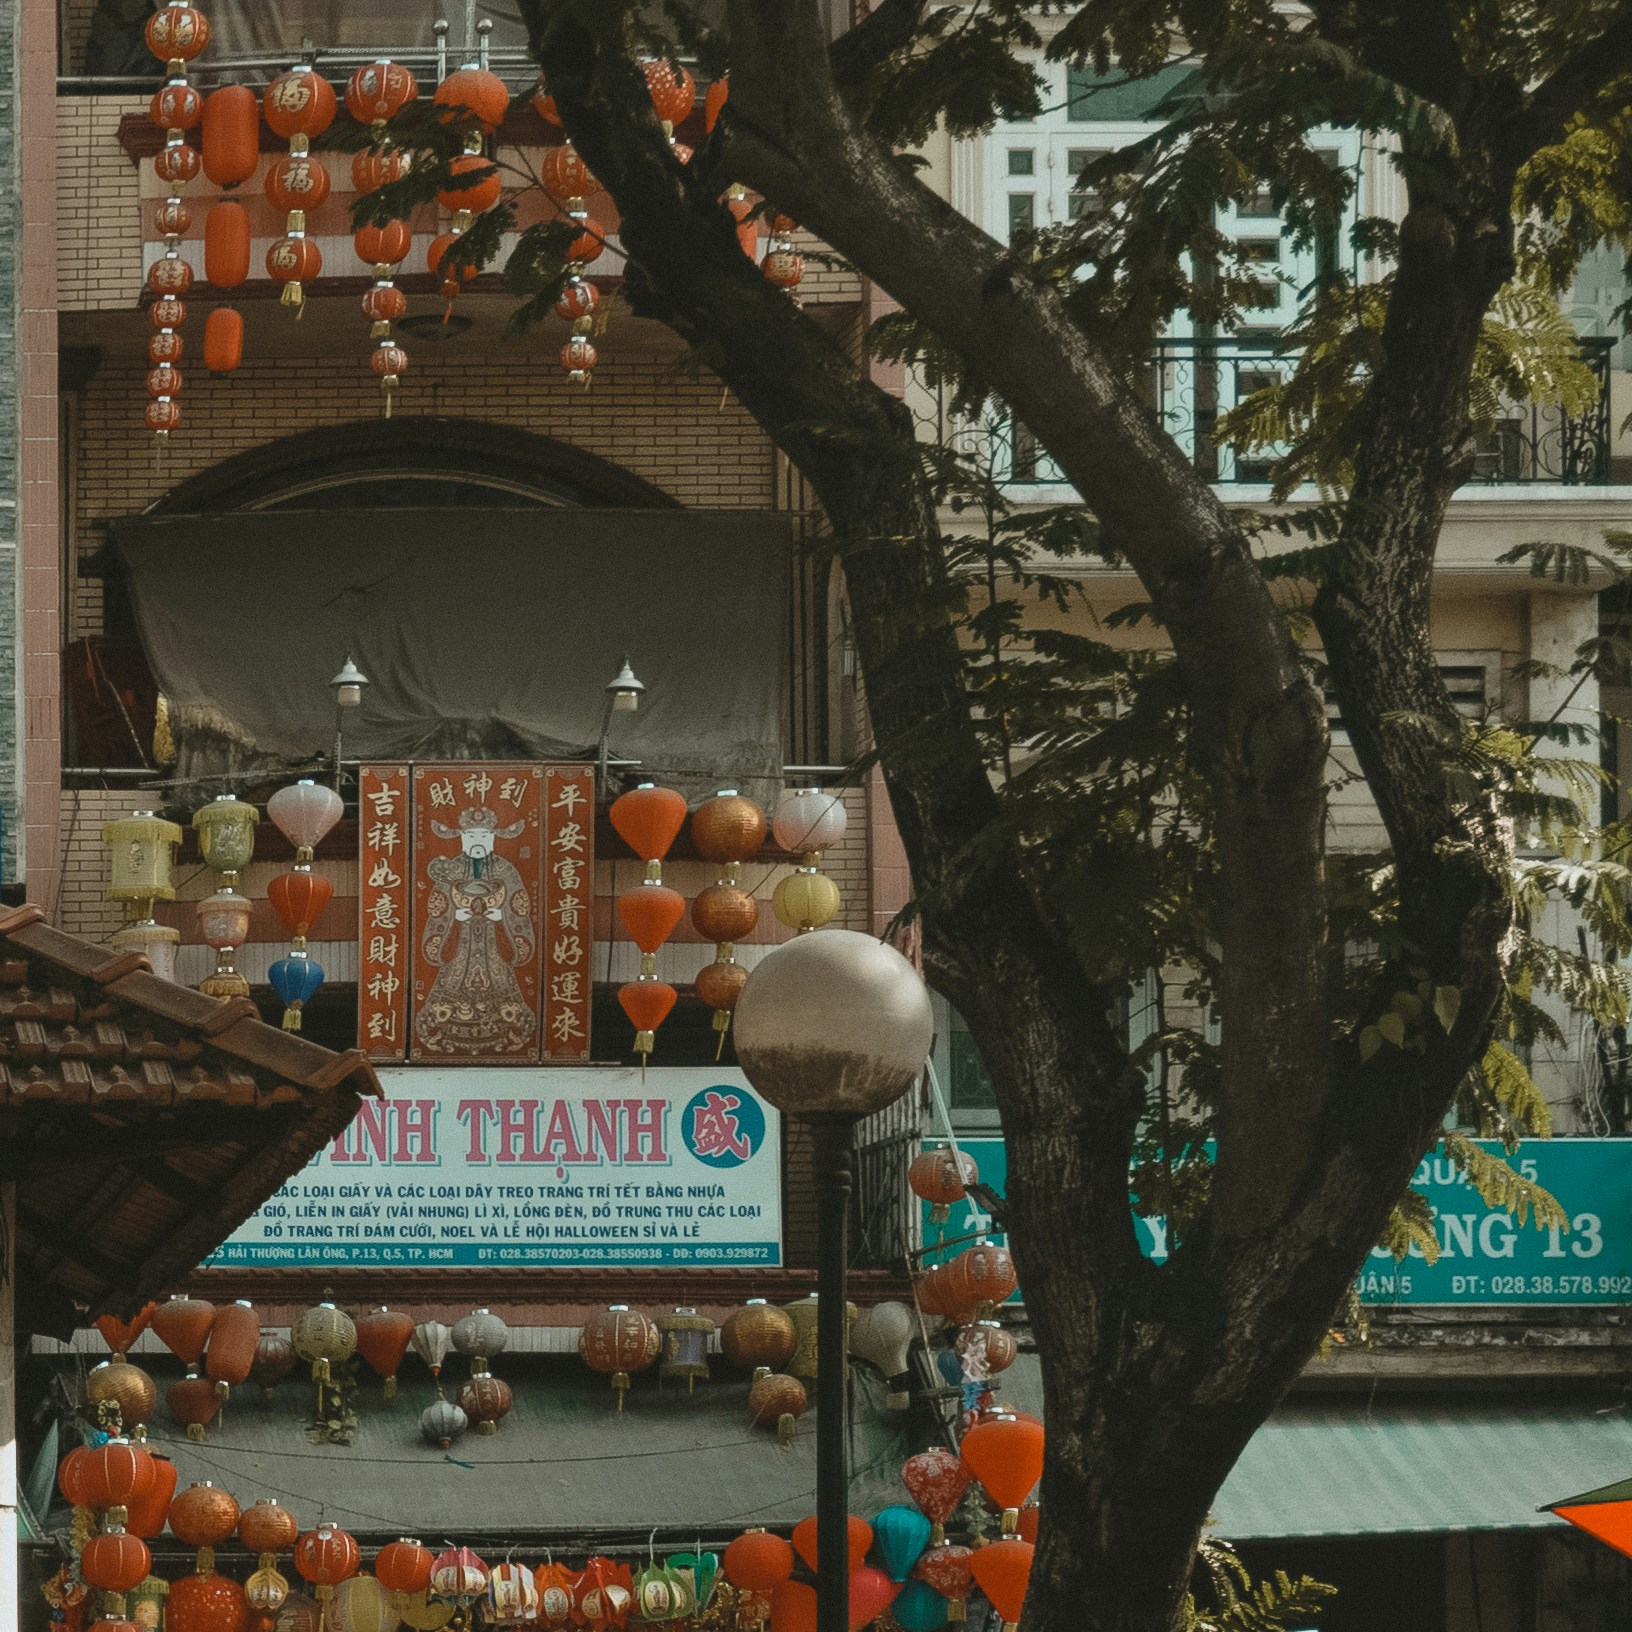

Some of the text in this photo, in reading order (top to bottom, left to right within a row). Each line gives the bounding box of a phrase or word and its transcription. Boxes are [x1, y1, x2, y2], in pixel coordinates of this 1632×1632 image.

[429, 771, 530, 809] 財神到
[366, 782, 403, 1042] 吉祥如意財神到
[550, 783, 588, 1042] 平安富貴好運來
[456, 1098, 670, 1181] THẠNH
[303, 1186, 335, 1200] LOẠI
[338, 1181, 371, 1198] GIẤY
[375, 1182, 393, 1198] VÀ
[397, 1181, 425, 1198] CÁC
[429, 1186, 461, 1200] LOẠI
[497, 1186, 534, 1198] TREO
[538, 1186, 584, 1198] TRANG
[588, 1182, 611, 1198] TRÍ
[331, 1206, 345, 1218] IN
[418, 1205, 470, 1220] NHUNG)
[615, 1206, 662, 1218] TRUNG
[666, 1206, 694, 1218] THU
[698, 1203, 726, 1218] CÁC
[730, 1206, 762, 1220] LOẠI
[287, 1226, 334, 1238] TRANG
[337, 1222, 361, 1238] TRÍ
[440, 1226, 476, 1238] NOEL
[554, 1226, 639, 1238] HALLOWEEN
[429, 1247, 454, 1260] HCM
